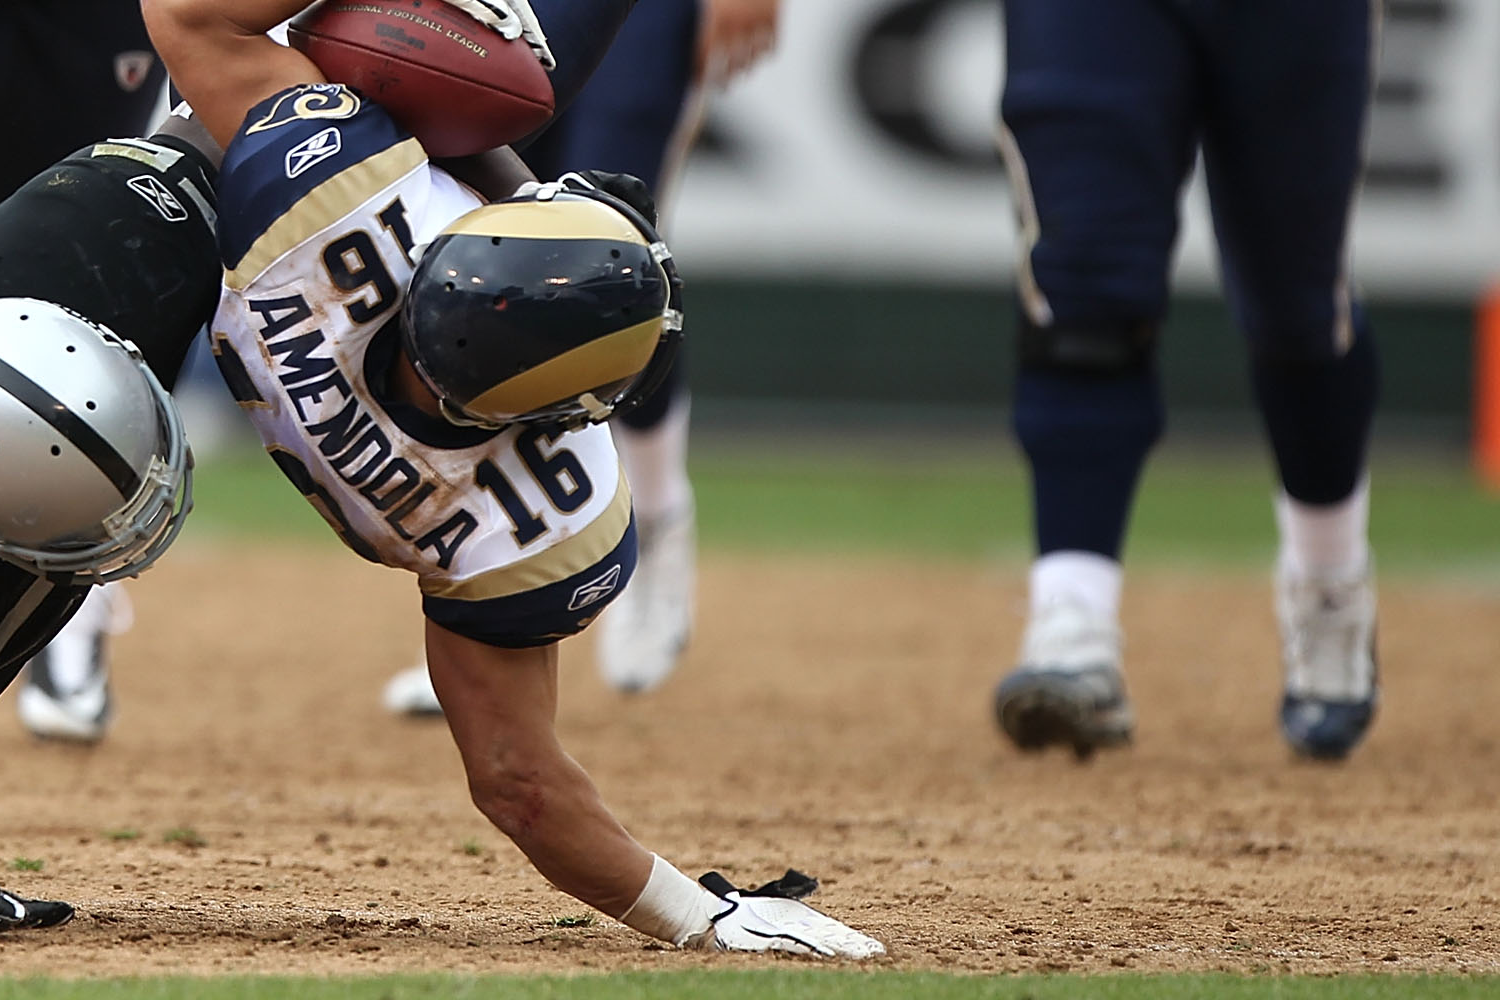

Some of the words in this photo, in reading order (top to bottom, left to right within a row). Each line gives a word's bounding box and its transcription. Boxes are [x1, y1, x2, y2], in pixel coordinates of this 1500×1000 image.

[387, 8, 443, 33] FOOTBALL
[446, 29, 489, 59] LEAGUE
[249, 293, 479, 570] AMENDOLA
[473, 420, 596, 551] 16
